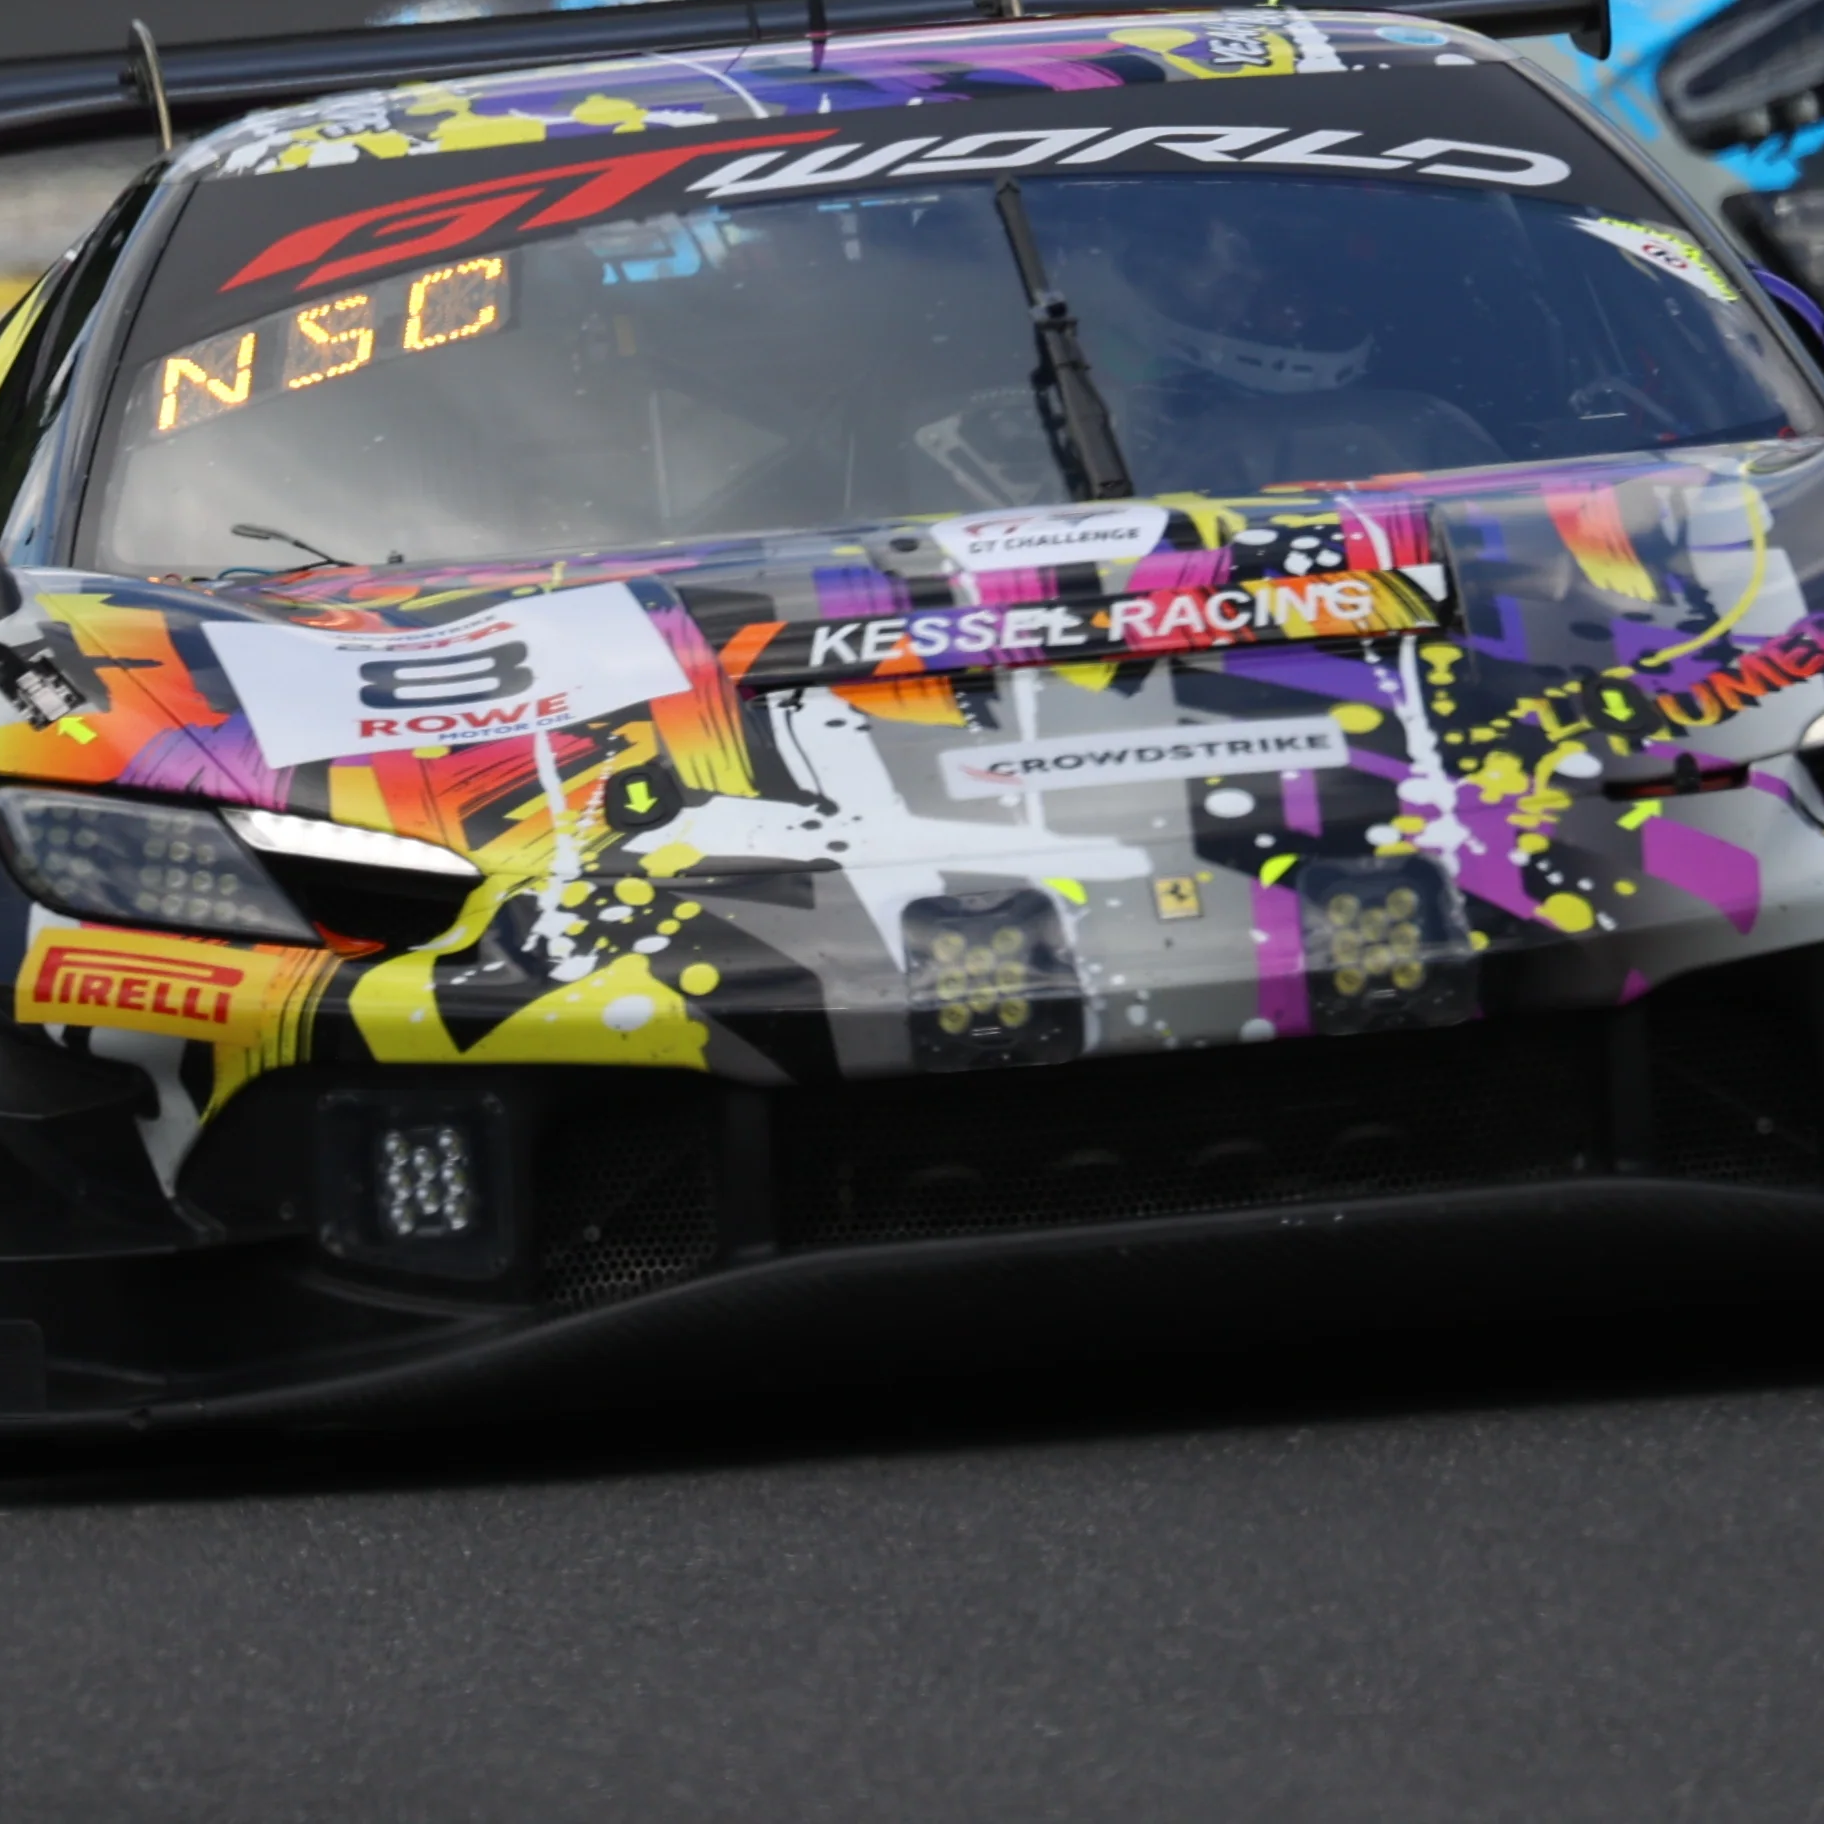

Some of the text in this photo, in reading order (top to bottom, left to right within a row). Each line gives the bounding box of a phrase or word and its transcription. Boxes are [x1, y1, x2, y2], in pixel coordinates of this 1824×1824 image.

[216, 122, 1572, 294] GT WORLD
[158, 257, 503, 432] NSC
[1004, 525, 1141, 552] CHALLENGE
[810, 578, 1375, 667] KESSEL RACING
[358, 640, 534, 710] 8
[356, 690, 570, 739] ROWE
[436, 710, 576, 742] MOTOR OIL
[986, 733, 1334, 778] CROWDSTRIKE
[33, 945, 245, 1025] PIRELLI
